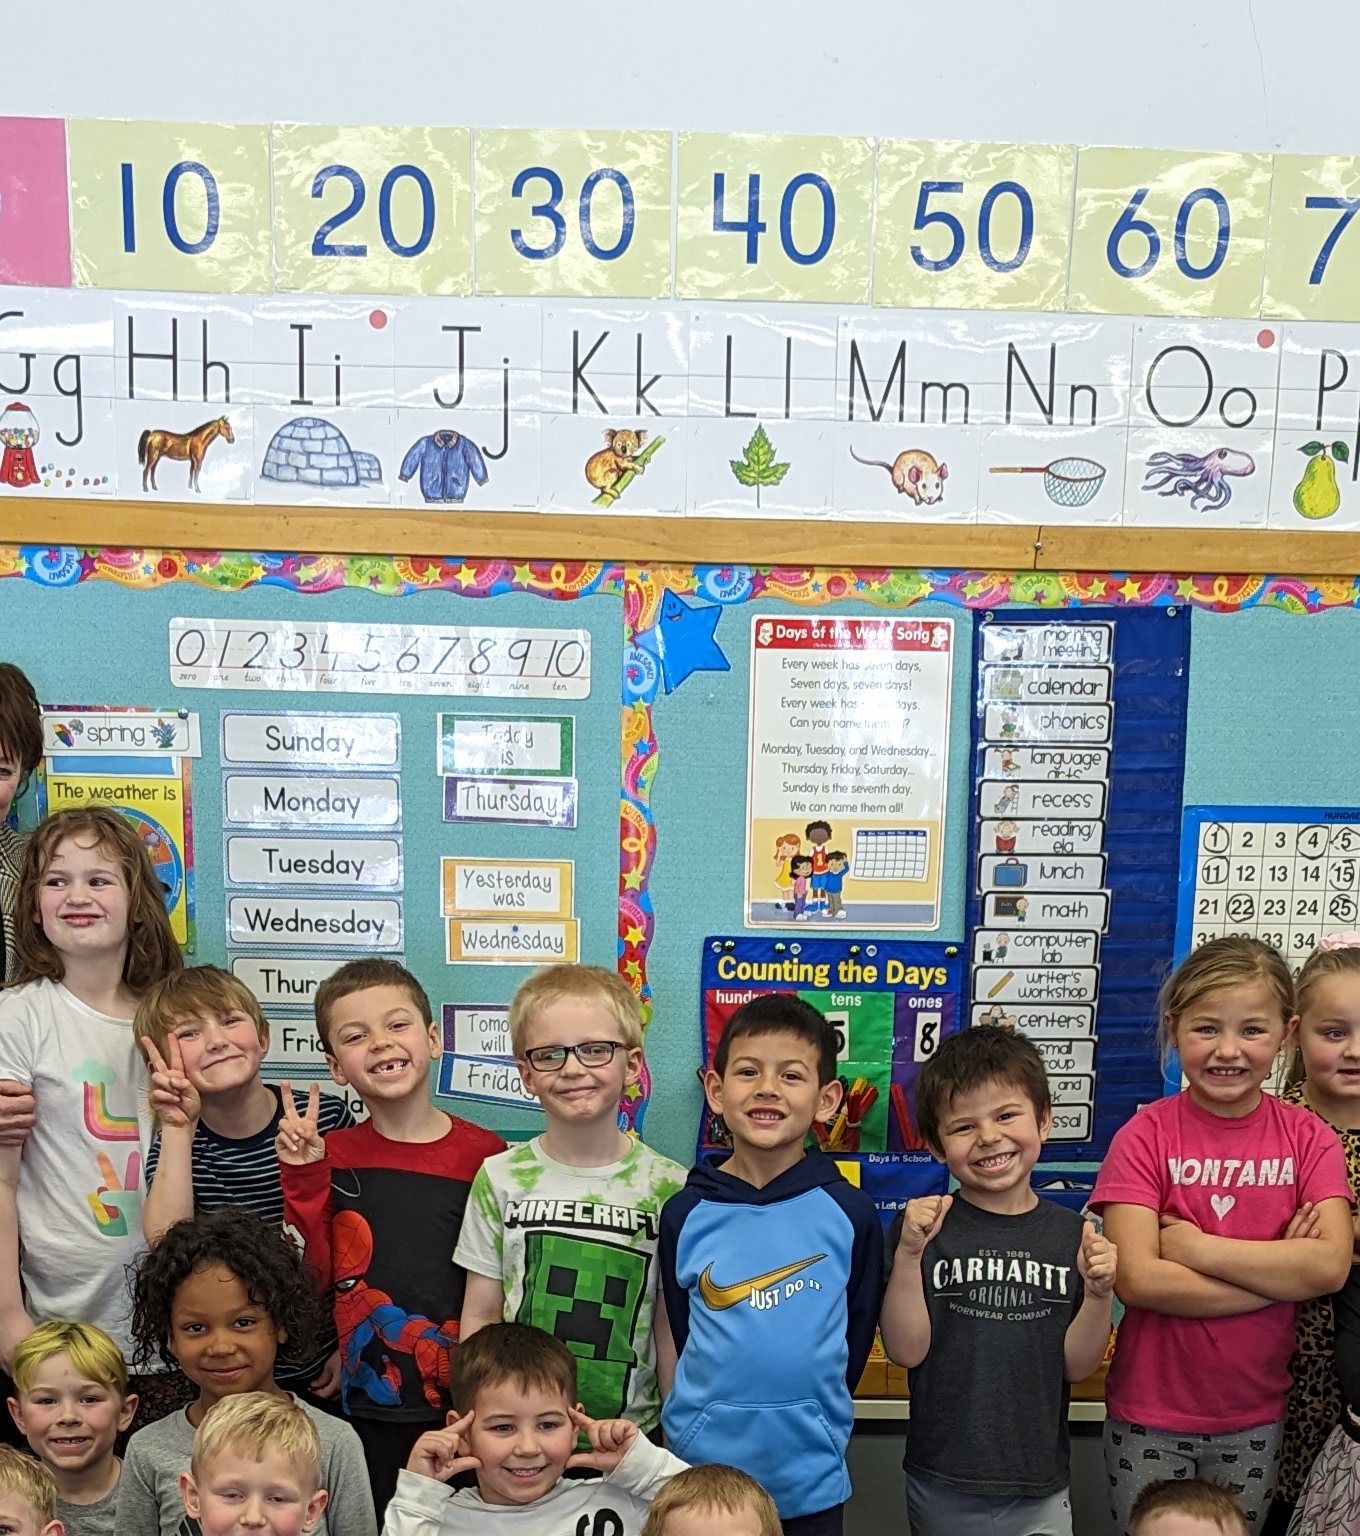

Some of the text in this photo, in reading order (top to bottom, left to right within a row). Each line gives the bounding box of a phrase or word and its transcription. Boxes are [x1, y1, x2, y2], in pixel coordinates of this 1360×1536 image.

[122, 161, 219, 255] 10
[311, 164, 435, 258] 20
[510, 167, 635, 260] 30
[713, 172, 837, 264] 40
[910, 181, 1035, 272] 50
[1107, 187, 1231, 279] 60
[128, 317, 229, 402] Hh
[290, 324, 341, 406] Ii
[433, 326, 510, 460] Jj
[572, 330, 658, 417] Kk
[725, 336, 790, 418] Ll
[848, 340, 971, 423] Mm
[1006, 343, 1098, 425] Nn
[1146, 345, 1257, 428] Oo
[776, 625, 807, 639] Days
[812, 626, 826, 638] of
[830, 626, 851, 638] the
[856, 627, 893, 640] Week
[897, 628, 929, 643] Song
[1044, 627, 1102, 645] morning
[176, 630, 584, 677] 0 1 2 3 5 6 7 8 9 10
[1043, 644, 1101, 661] meeting
[1028, 678, 1103, 696] calendar
[1041, 712, 1106, 731] phonics
[87, 724, 145, 746] spring
[265, 725, 355, 758] Sunday
[482, 725, 533, 748] Today
[501, 749, 513, 766] is
[1031, 749, 1101, 769] language
[54, 783, 176, 800] The weather is
[783, 782, 912, 796] Sunday is the seventh day.
[263, 787, 360, 819] Monday
[461, 785, 557, 816] Thursday
[790, 801, 806, 811] We
[809, 804, 826, 812] can
[861, 802, 886, 812] them
[889, 803, 903, 813] all!
[1032, 794, 1093, 808] recess
[1032, 821, 1096, 841] reading/
[1053, 838, 1073, 853] ela
[262, 848, 365, 880] Tuesday
[1040, 862, 1084, 879] lunch
[464, 869, 552, 893] Yesterday
[1236, 866, 1320, 881] 12 13 14
[493, 892, 525, 907] was
[1042, 901, 1088, 918] math
[244, 908, 385, 940] Wednesday
[462, 930, 564, 953] Wednesday
[1014, 934, 1092, 950] computer
[1042, 950, 1062, 963] lab
[718, 956, 946, 990] Counting the Days
[1027, 971, 1081, 984] writer's
[831, 993, 861, 1006] tens
[908, 995, 942, 1008] ones
[1018, 986, 1087, 999] workshop
[1018, 1012, 1086, 1029] centers
[920, 1021, 935, 1051] 8
[1058, 1079, 1081, 1090] and
[869, 1154, 931, 1163] Days School
[504, 1200, 659, 1241] MINECRAFT
[979, 1250, 1030, 1259] EST. 1889
[933, 1258, 1071, 1296] CARHARTT
[749, 1279, 822, 1311] JUST DO IT
[969, 1286, 1034, 1308] ORIGINAL
[949, 1302, 1052, 1321] WORKWEAR COMPANY
